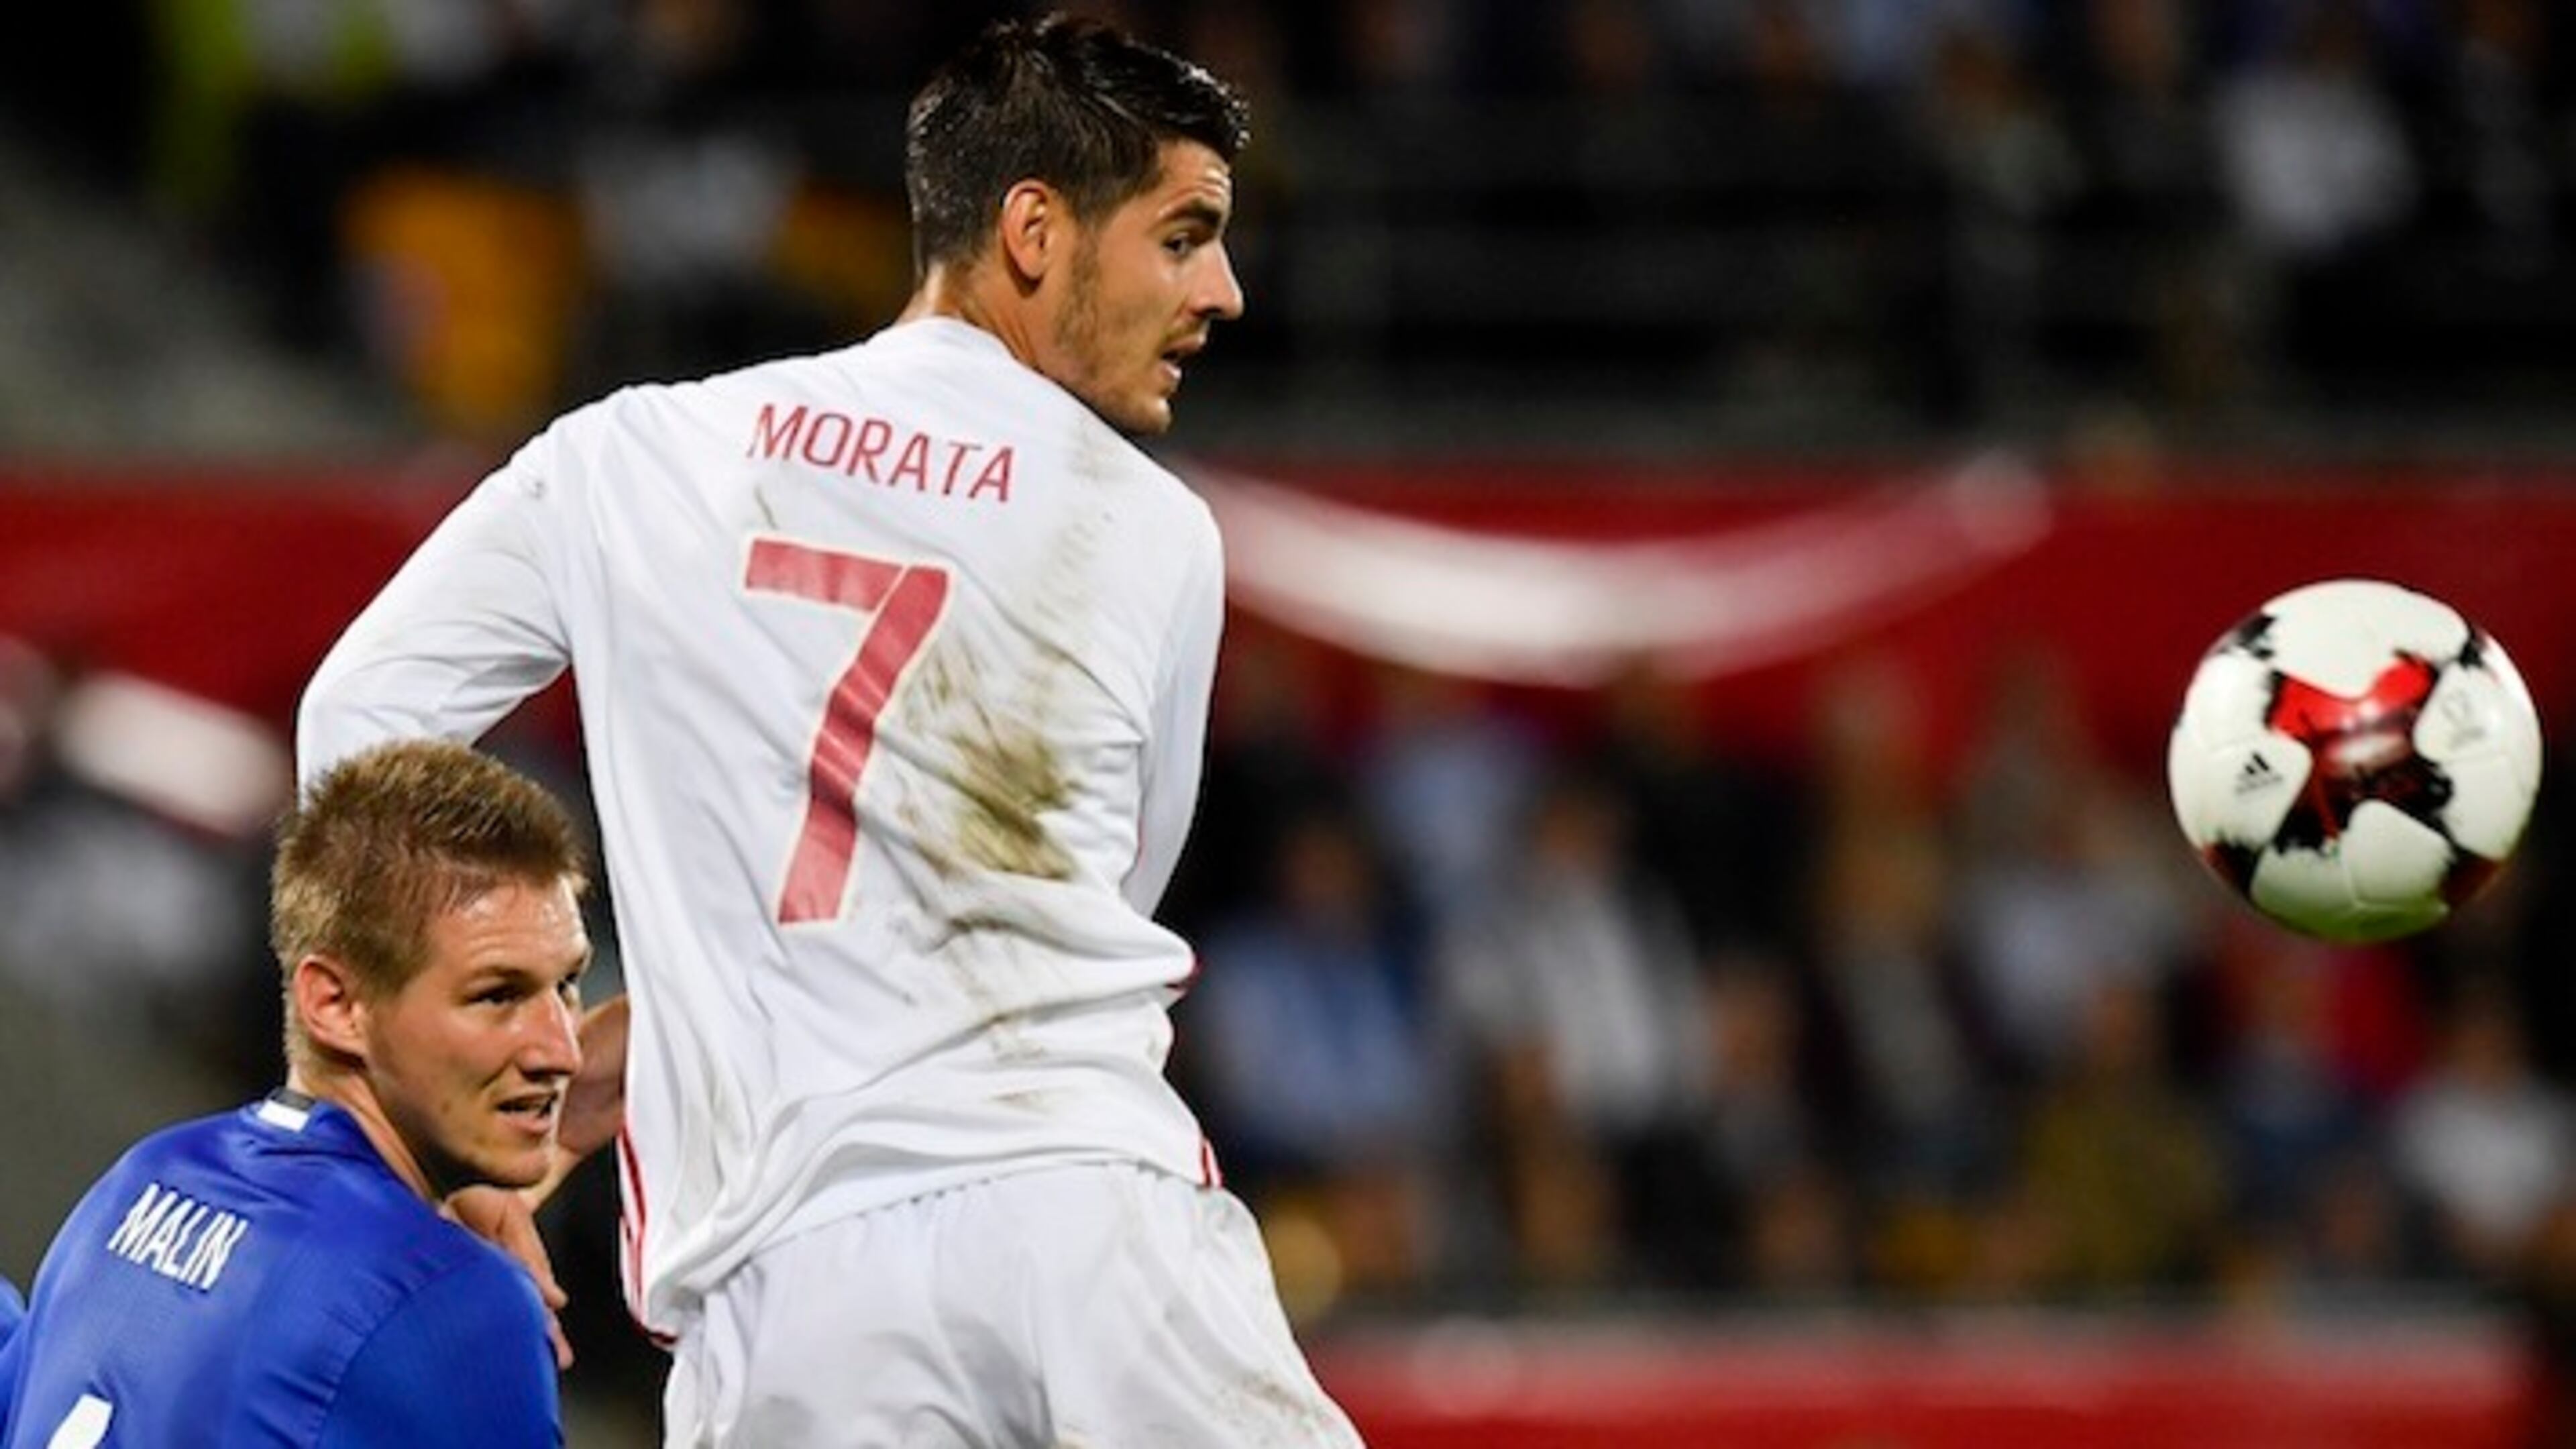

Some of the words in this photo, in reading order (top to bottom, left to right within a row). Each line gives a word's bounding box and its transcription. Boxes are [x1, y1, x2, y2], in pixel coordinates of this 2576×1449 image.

[746, 403, 1015, 503] MORATA
[744, 536, 951, 924] 7
[107, 1183, 249, 1289] MALIN
